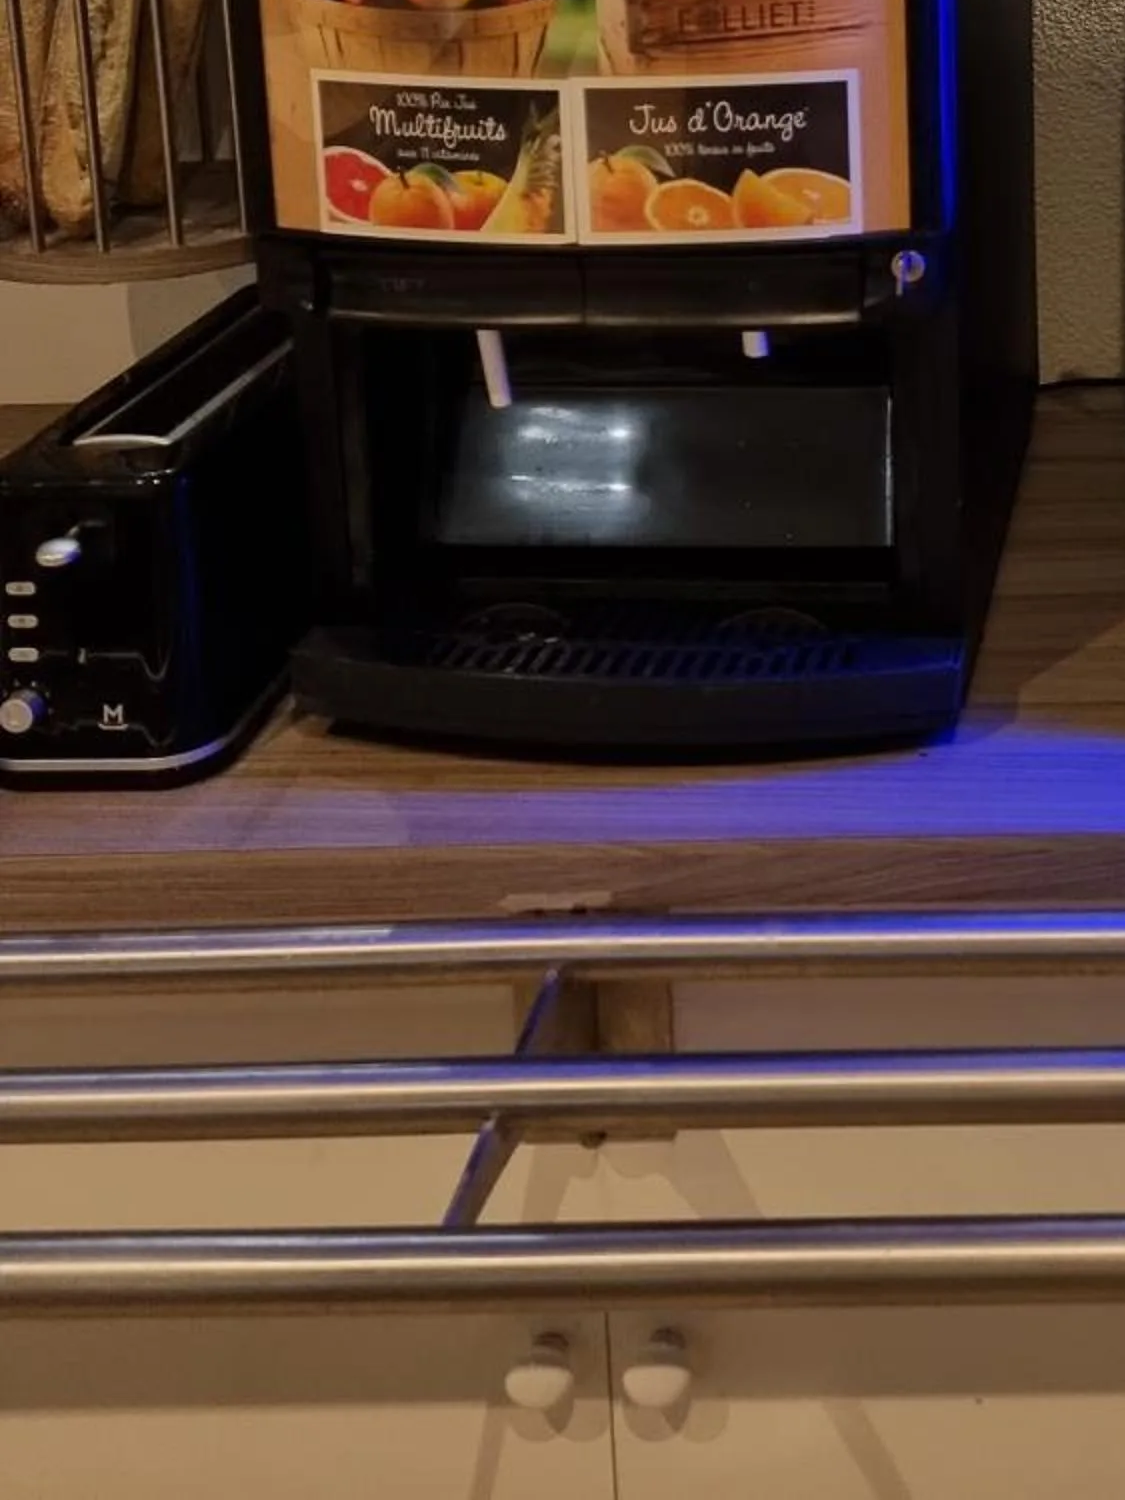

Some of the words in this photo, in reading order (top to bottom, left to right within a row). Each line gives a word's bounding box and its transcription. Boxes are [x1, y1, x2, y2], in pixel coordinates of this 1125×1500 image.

[369, 105, 507, 150] Multifruits
[629, 104, 677, 135] Jus
[687, 101, 807, 142] d'Orange
